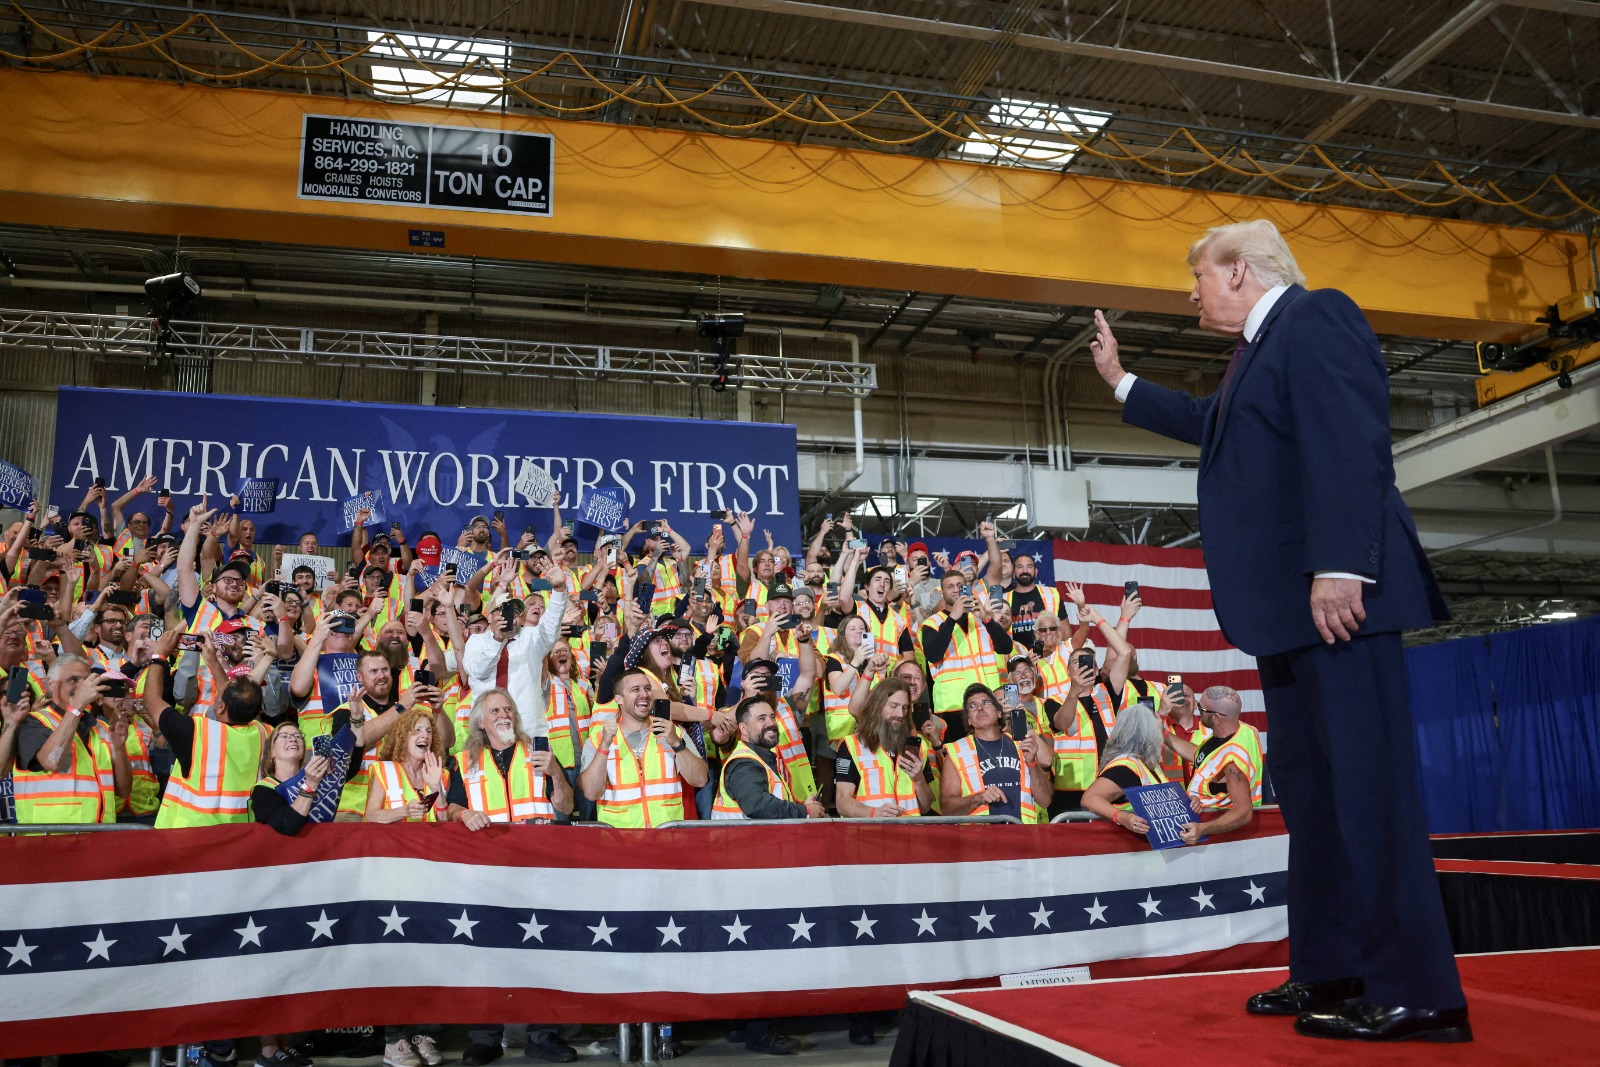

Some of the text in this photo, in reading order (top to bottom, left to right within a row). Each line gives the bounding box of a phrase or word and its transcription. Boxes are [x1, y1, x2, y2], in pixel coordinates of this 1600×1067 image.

[330, 122, 403, 141] HANDLING
[312, 138, 419, 160] SERVICES, INC.
[477, 144, 513, 167] 10
[314, 156, 415, 176] 864-299-1821
[325, 173, 403, 188] CRANES HOISTS
[434, 170, 546, 200] TON CAP.
[303, 183, 422, 202] MONORAILS CONVEYORS
[0, 461, 31, 486] MERICAN
[0, 472, 31, 492] RKERS
[65, 433, 789, 516] AMERICAN WORKERS FIRST
[0, 483, 29, 506] RST
[244, 480, 275, 491] AMERICAN
[522, 479, 552, 503] FIRST
[242, 497, 273, 512] FIRST
[590, 499, 623, 519] WORKERS
[591, 493, 624, 511] AMERICAN
[344, 508, 376, 529] FIT
[585, 507, 621, 531] FIRST
[291, 557, 327, 568] AMERICAN
[441, 547, 479, 567] AMERICAN
[1138, 787, 1180, 805] AMERICAN
[1143, 799, 1188, 819] WORKERS
[1151, 813, 1192, 844] FIRST
